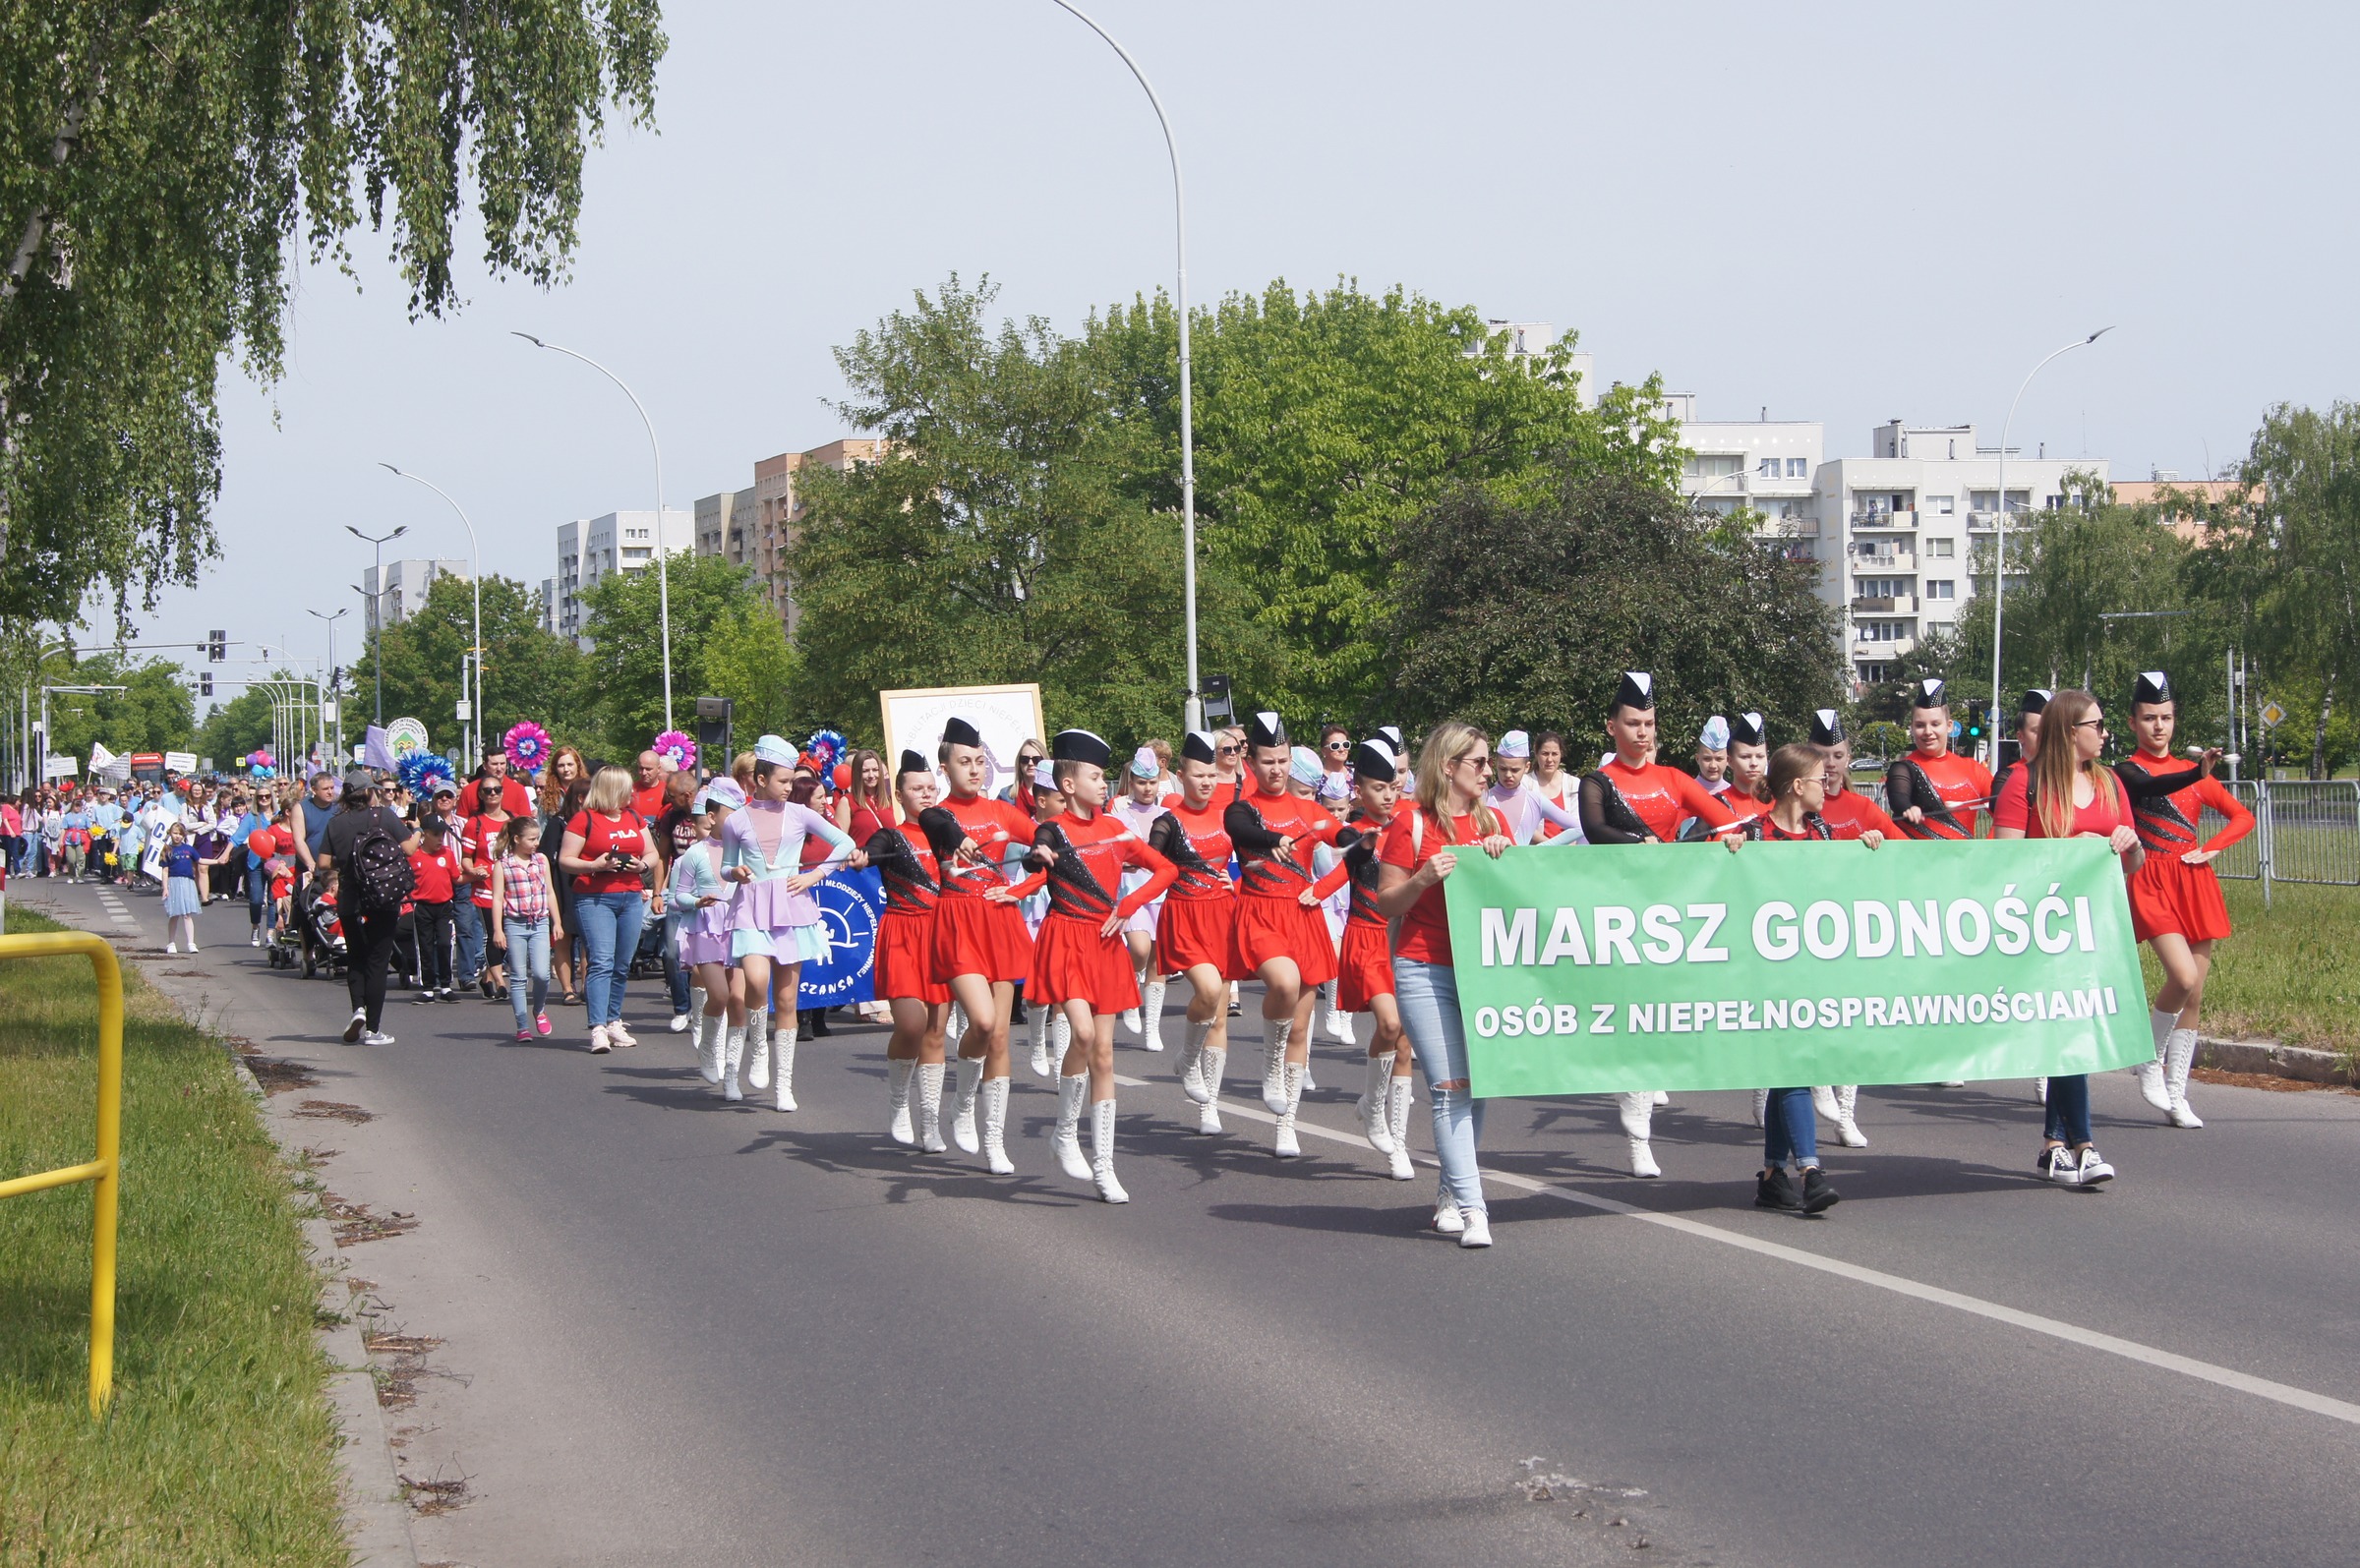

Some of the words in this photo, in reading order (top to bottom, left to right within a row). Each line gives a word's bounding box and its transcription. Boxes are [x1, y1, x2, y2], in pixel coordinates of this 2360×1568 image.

[906, 703, 947, 748] ABILITACJI
[949, 698, 986, 710] DZIECI
[989, 705, 1029, 740] NIEPEŁN
[609, 829, 638, 840] FILA
[826, 879, 865, 903] MŁODZIEŻY
[856, 901, 879, 978] NIEPEŁNORAWNEJ
[1480, 902, 1729, 966] MARSZ
[1751, 882, 2095, 961] GODNOŚĆI
[798, 975, 855, 996] SZANSA
[1475, 998, 1578, 1037] OSÓB
[1589, 1004, 1616, 1033] Z
[1628, 986, 2118, 1033] NIEPEŁNOSPRAWNOŚCIAMI
